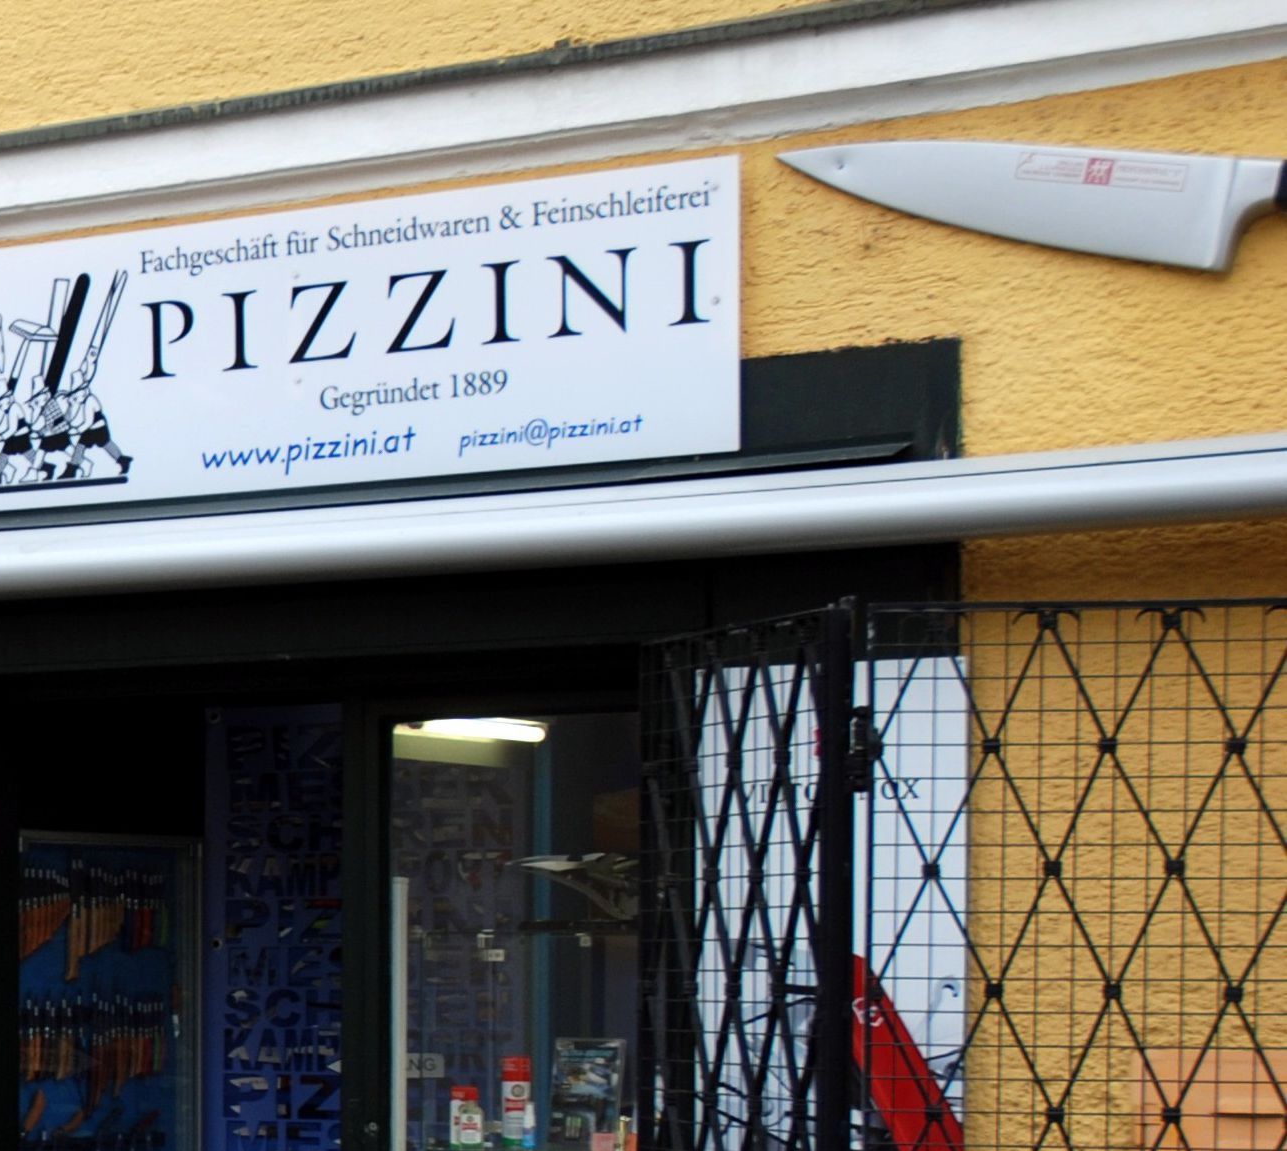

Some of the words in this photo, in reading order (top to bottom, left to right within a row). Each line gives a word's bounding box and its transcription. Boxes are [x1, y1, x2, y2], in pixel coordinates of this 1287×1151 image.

[141, 234, 278, 276] Fachgeschäft
[287, 231, 319, 256] für
[328, 216, 489, 251] Schneidwaren
[500, 206, 521, 230] &
[532, 184, 711, 227] Feinschleiferei
[142, 235, 709, 383] PIZZINI
[320, 378, 439, 416] Gegründet
[452, 370, 507, 397] 1889
[202, 427, 420, 477] www.pizzini.at
[459, 415, 643, 456] pizzini@pizzini.at
